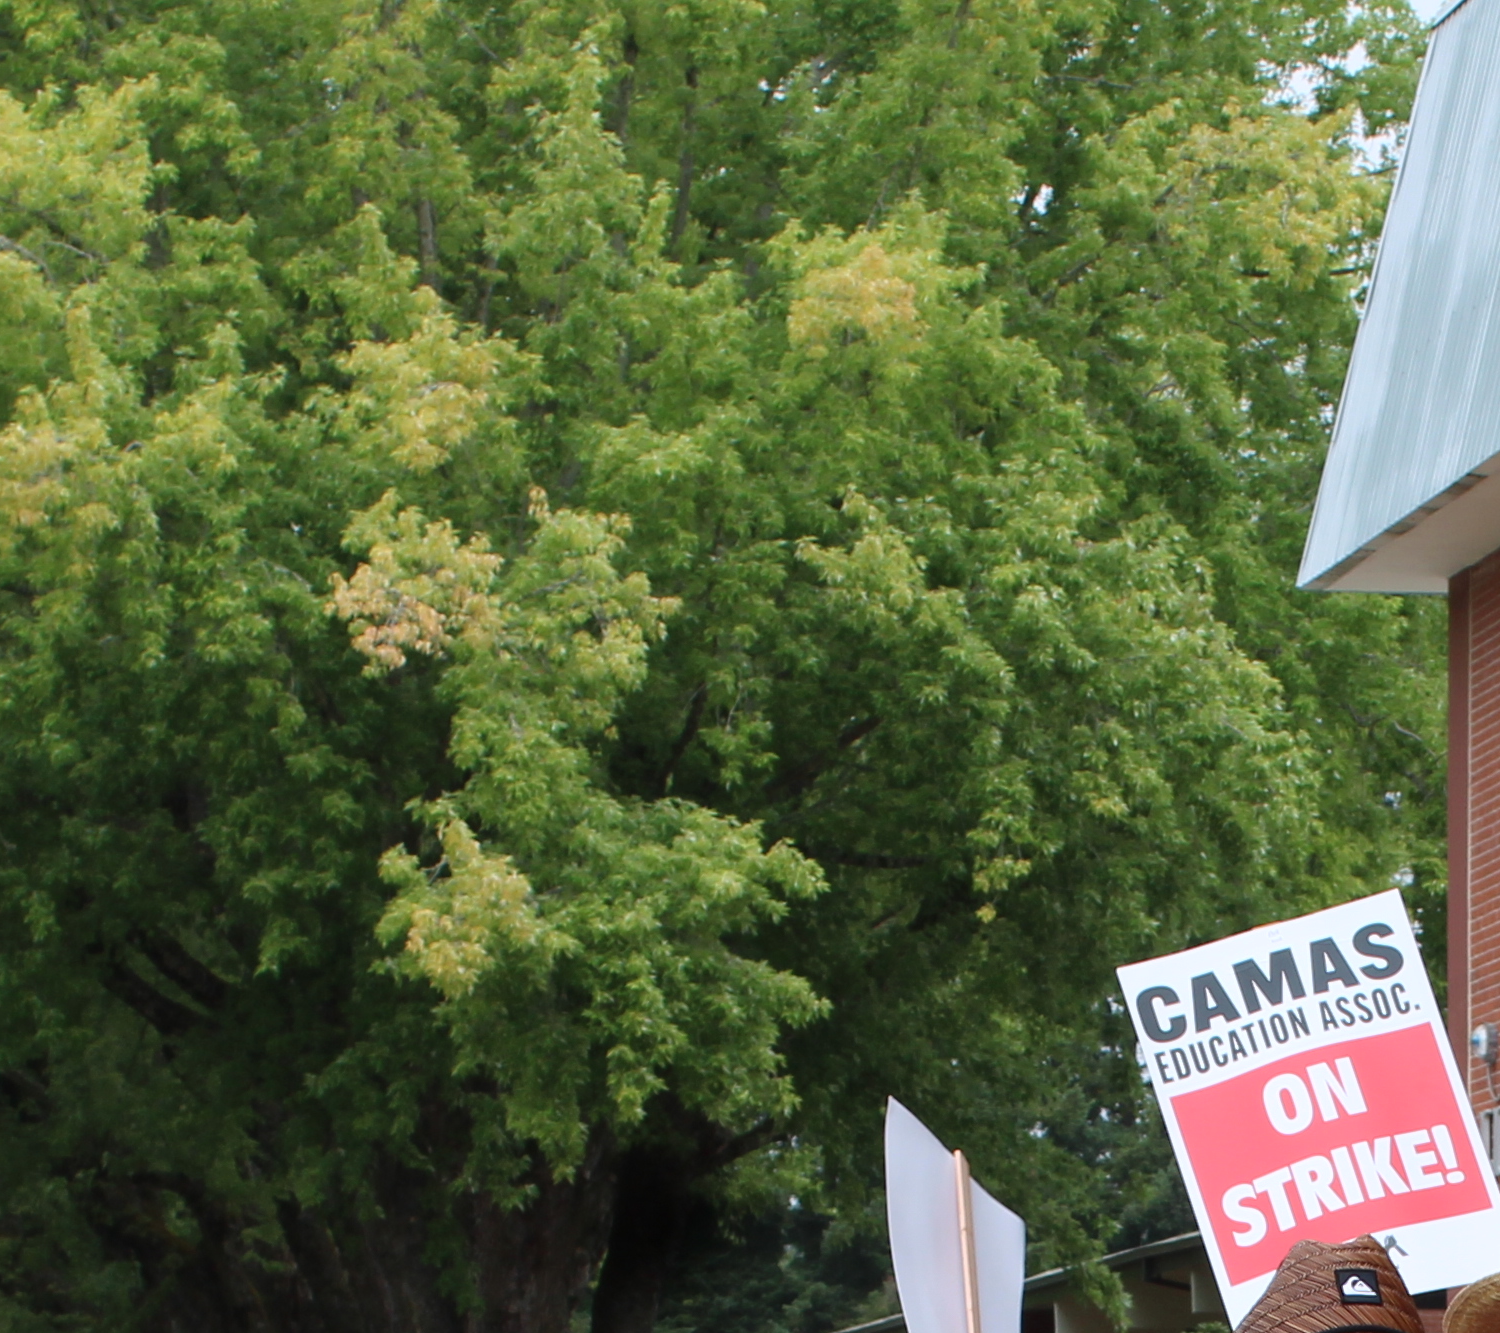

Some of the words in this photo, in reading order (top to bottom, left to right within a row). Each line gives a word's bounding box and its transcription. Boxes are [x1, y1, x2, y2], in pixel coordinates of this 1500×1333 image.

[1136, 921, 1405, 1044] CAMAS
[1154, 1011, 1311, 1085] EDUCATION
[1321, 982, 1421, 1032] ASSOC.
[1260, 1055, 1369, 1137] ON
[1220, 1123, 1467, 1248] STRIKE!
